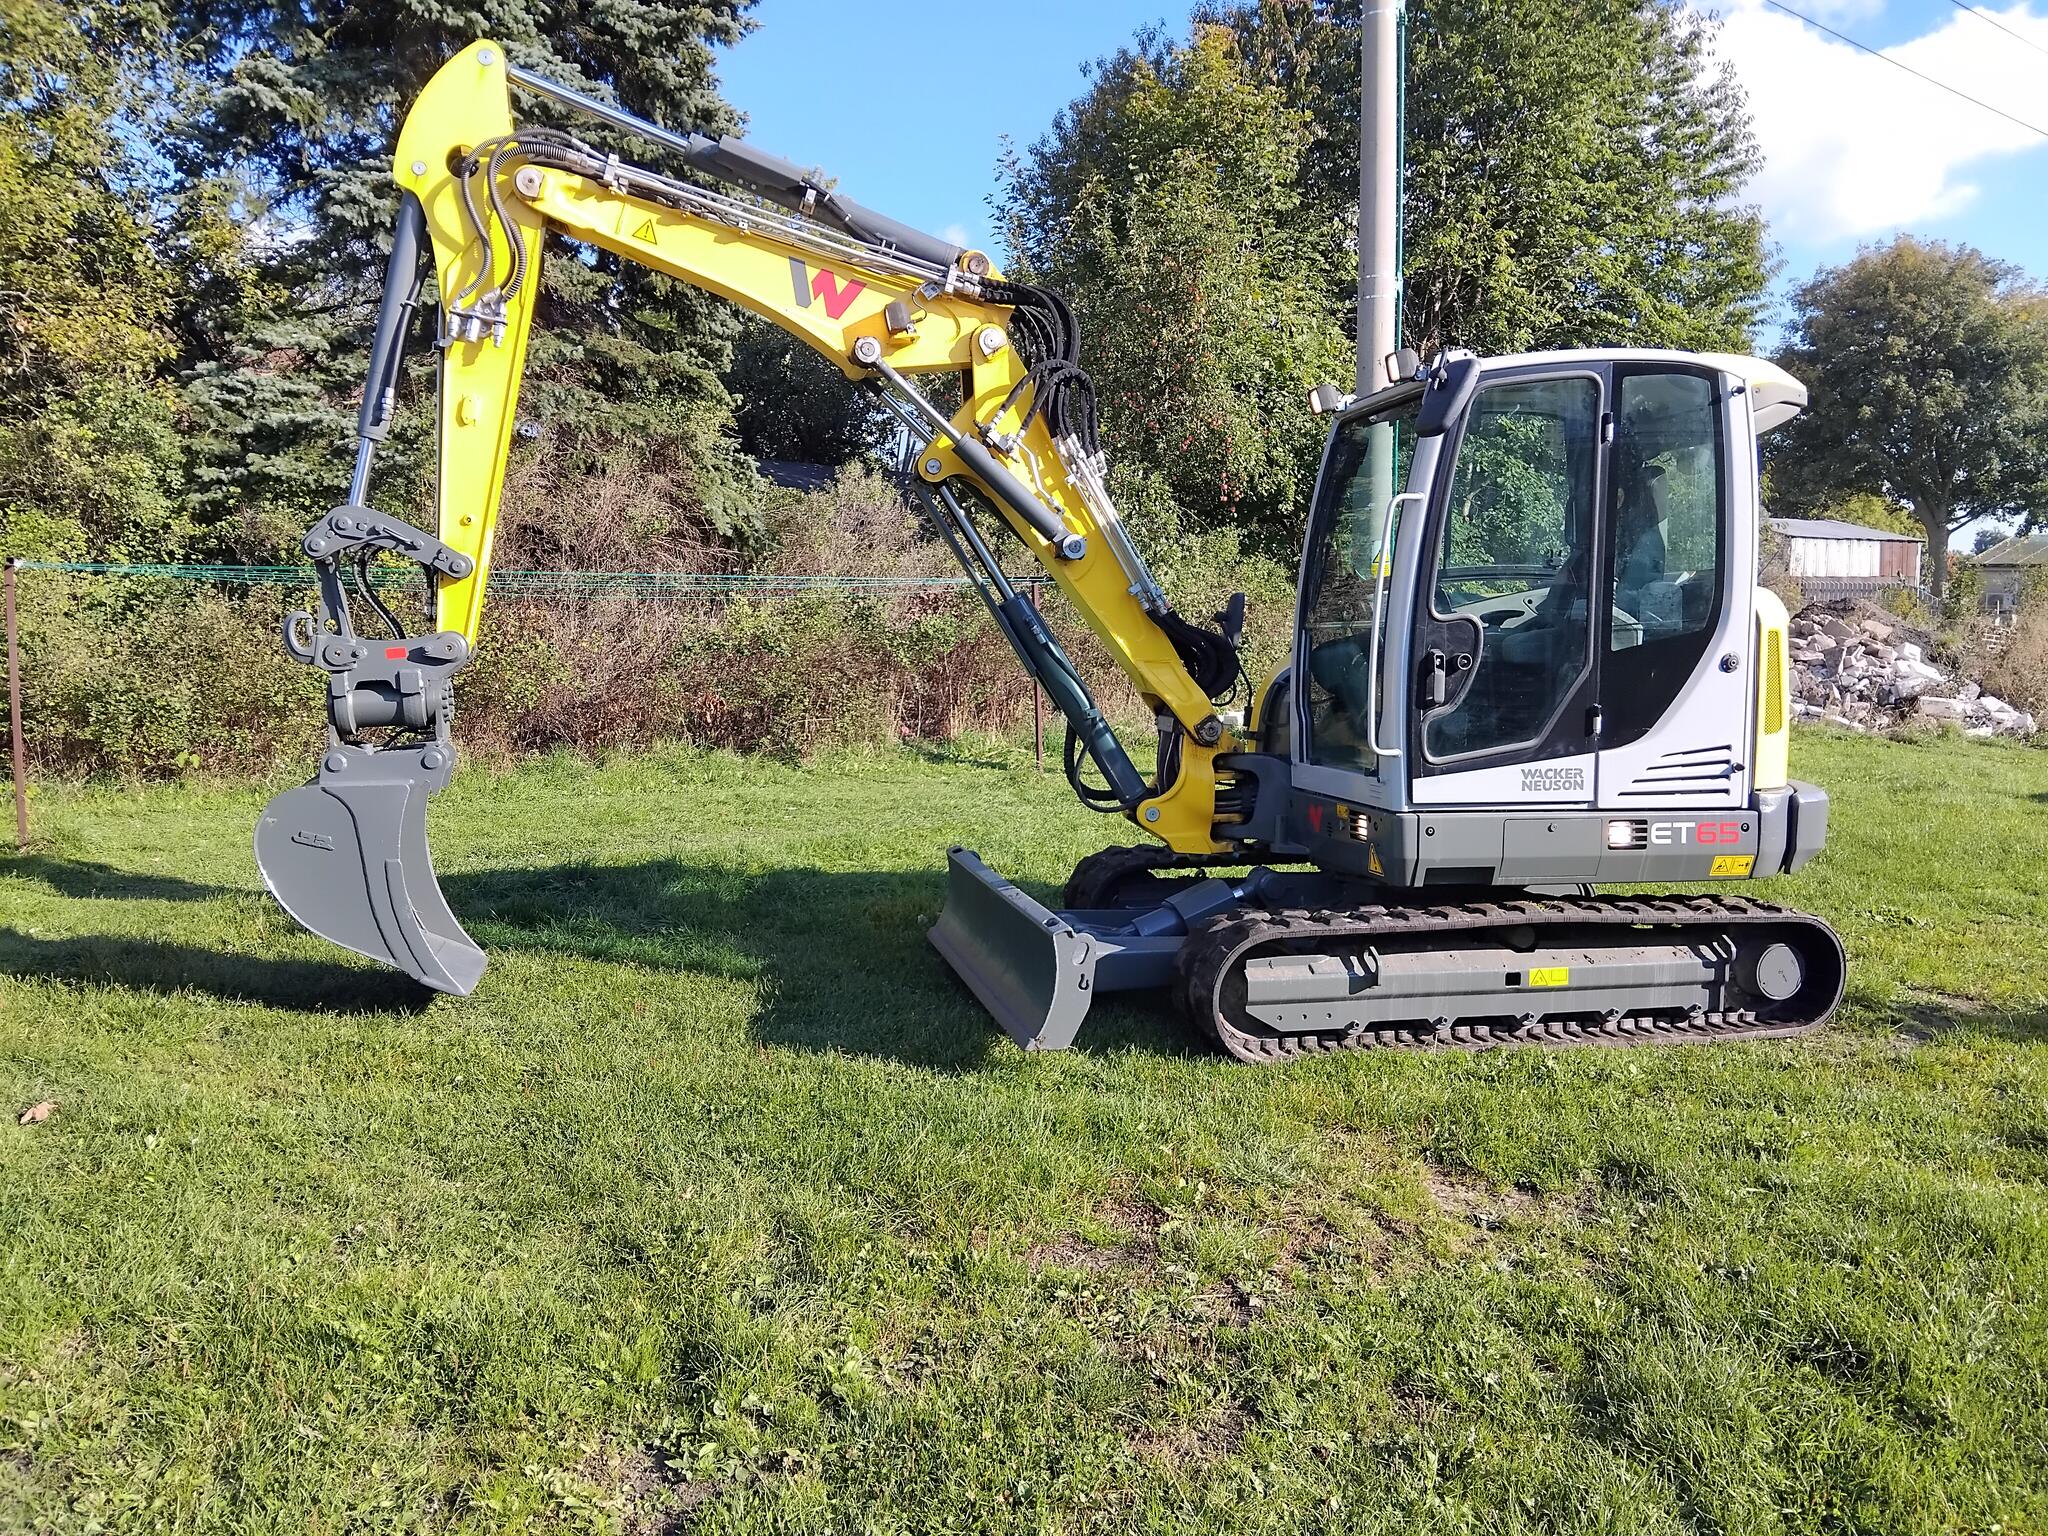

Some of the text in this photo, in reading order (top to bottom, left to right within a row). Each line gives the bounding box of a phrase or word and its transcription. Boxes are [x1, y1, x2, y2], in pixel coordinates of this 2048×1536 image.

[1520, 768, 1584, 780] WACKER
[1521, 779, 1584, 791] NEUSON
[1650, 821, 1740, 845] ET65
